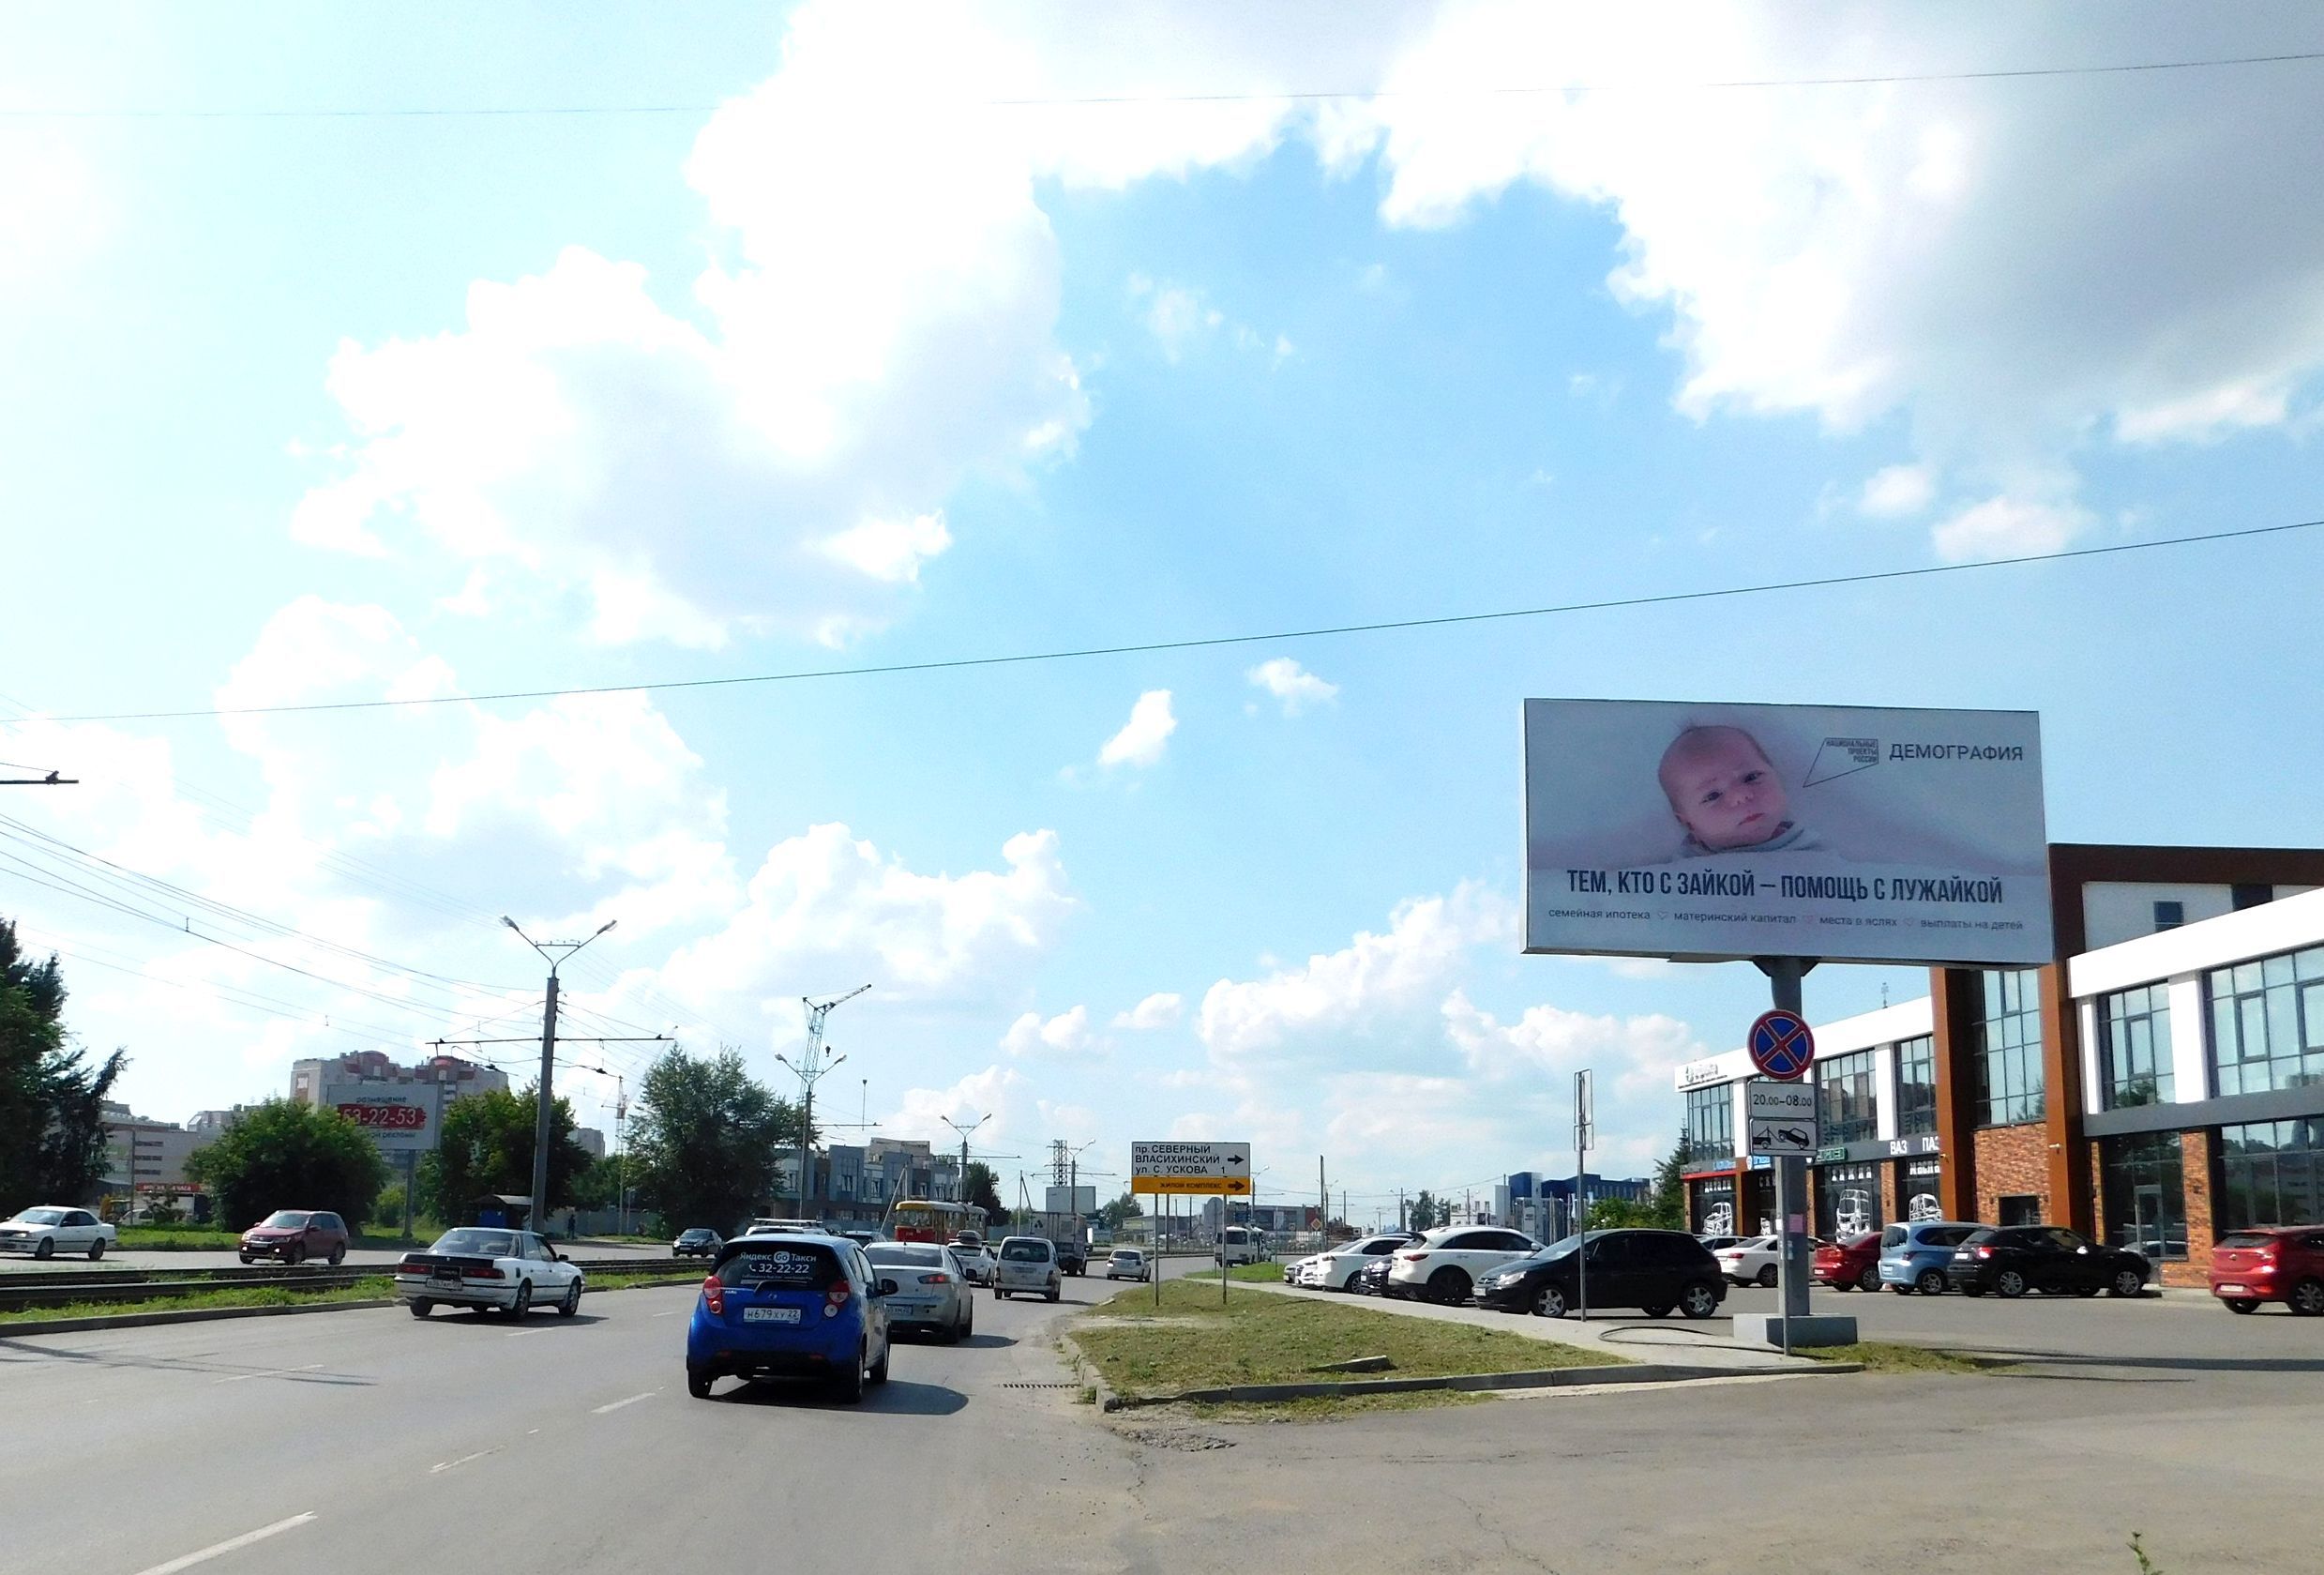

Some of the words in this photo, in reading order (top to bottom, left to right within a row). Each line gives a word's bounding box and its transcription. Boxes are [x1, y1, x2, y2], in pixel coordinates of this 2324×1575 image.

[1890, 743, 2023, 761] ДЕМОГРАФИЯ
[1567, 870, 1612, 896] ТЕМ,
[1618, 871, 1654, 895] КТО
[1660, 871, 1672, 895] С
[1677, 869, 1755, 897] ЗАЙКОЙ
[1781, 875, 1868, 901] ПОМОЩЬ
[1874, 877, 1885, 901] С
[1891, 875, 2003, 903] ЛУЖАЙКОЙ
[1548, 907, 1603, 918] семейная
[1606, 910, 1651, 920] ипотека
[1674, 912, 1747, 923] материнский
[1751, 914, 1797, 924] капитал
[1819, 916, 1852, 926] места
[1865, 917, 1897, 927] яслях
[1921, 918, 1971, 929] выплаты
[1975, 921, 1988, 930] на
[1991, 919, 2024, 931] детей
[342, 1108, 417, 1126] 53-22-53
[1152, 1143, 1211, 1154] СЕВЕРНЫЙ
[1890, 1140, 1908, 1156] ВАЗ
[1135, 1154, 1220, 1164] ВЛАСИХИНСКИЙ
[1167, 1165, 1208, 1174] УСКОВА
[740, 1251, 772, 1261] Яндекс
[791, 1253, 817, 1262] Такси
[758, 1263, 809, 1274] 32-22-22
